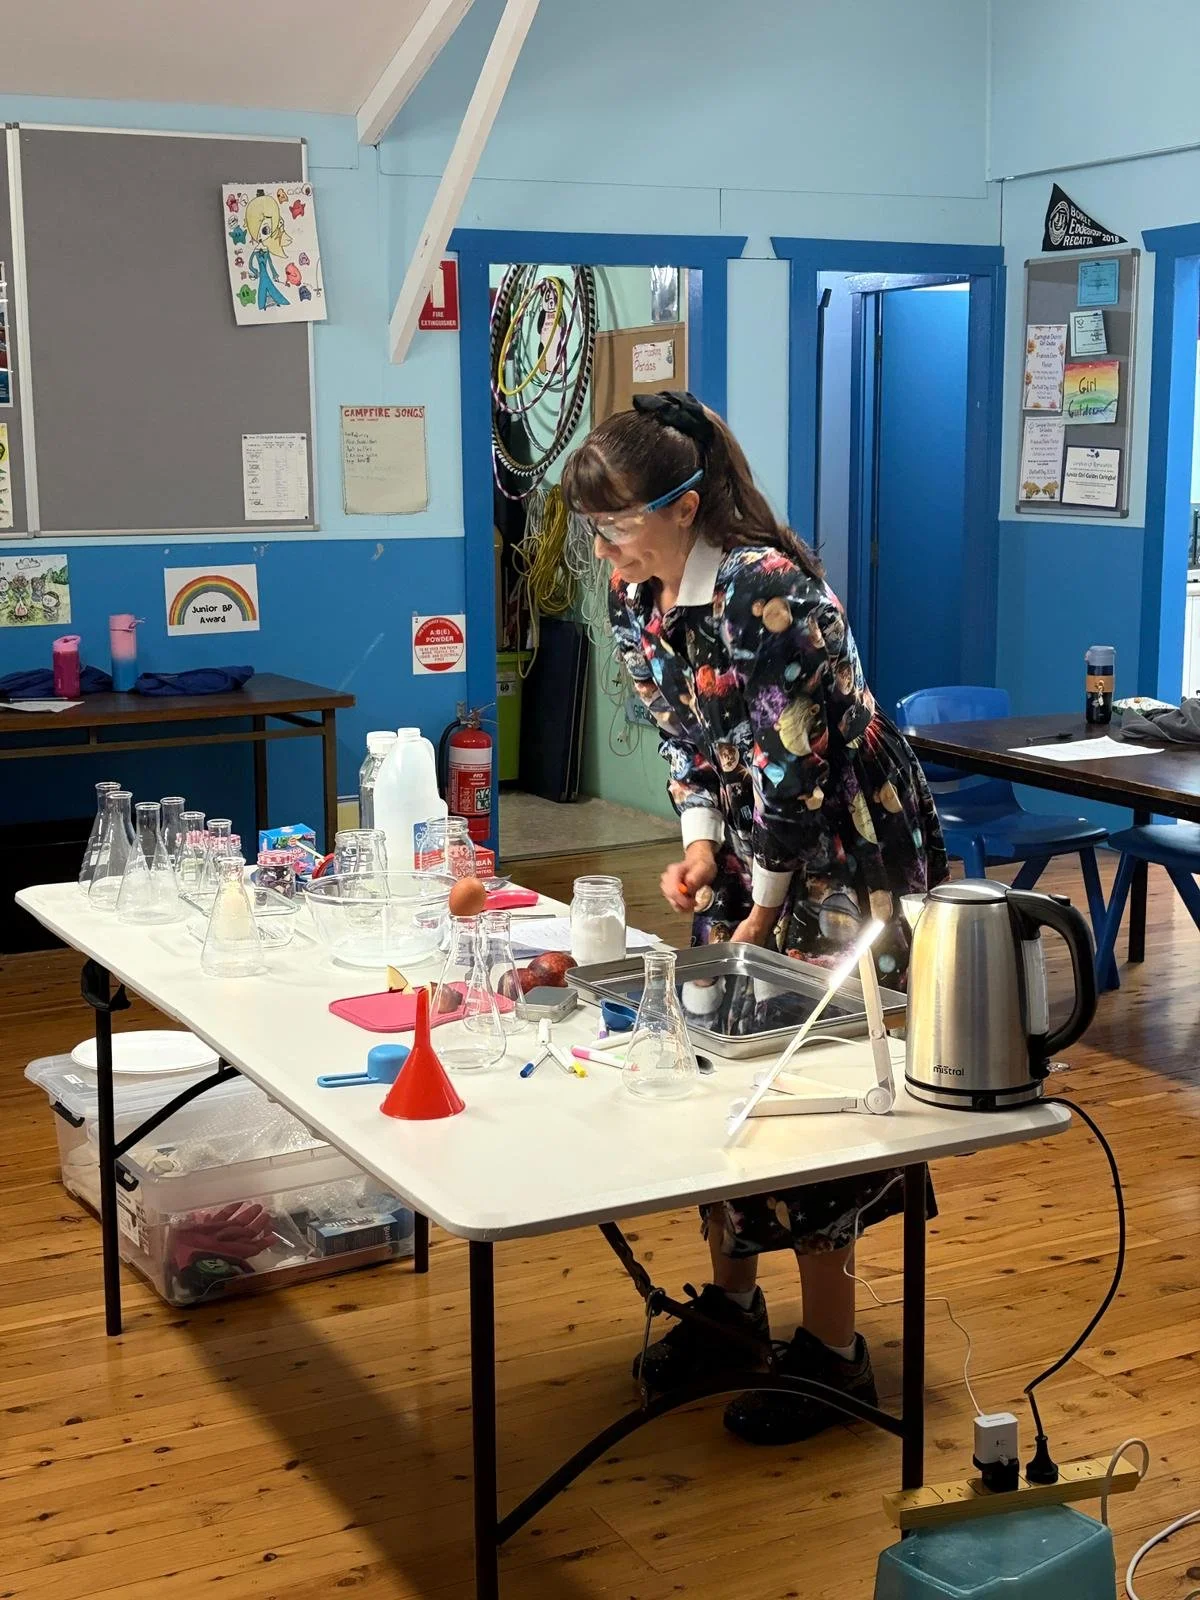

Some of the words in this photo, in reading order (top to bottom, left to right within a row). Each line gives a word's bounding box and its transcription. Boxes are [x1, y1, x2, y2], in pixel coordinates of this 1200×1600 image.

[1063, 235, 1093, 246] REGATTA
[1102, 234, 1120, 243] 2018
[1079, 376, 1096, 394] Girl
[344, 408, 391, 418] CAMPFIRE
[395, 408, 424, 418] SONGS
[192, 605, 218, 613] Junior
[222, 604, 233, 612] BP
[200, 616, 226, 624] Award
[933, 1065, 965, 1076] mistral
